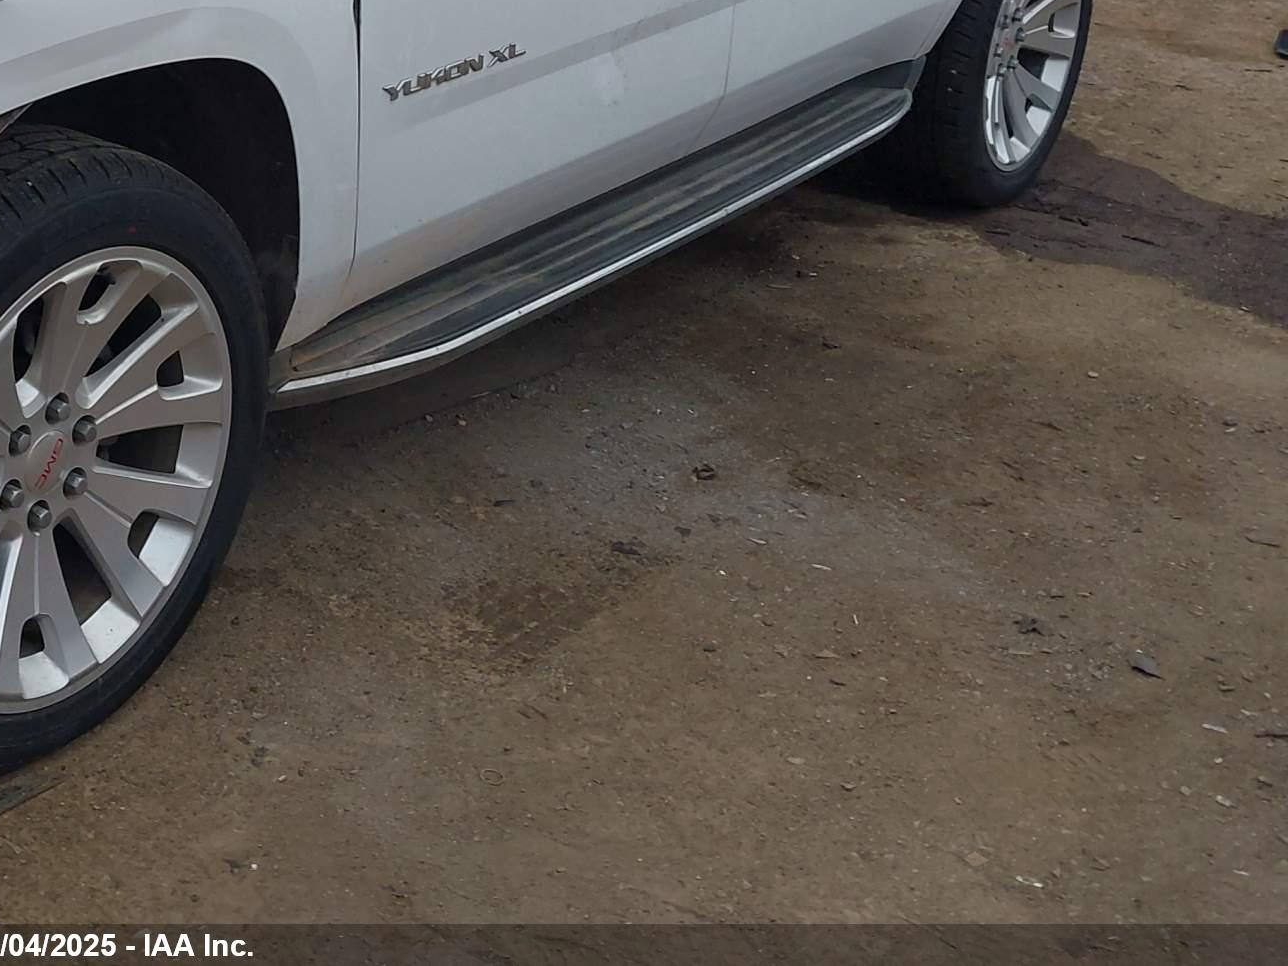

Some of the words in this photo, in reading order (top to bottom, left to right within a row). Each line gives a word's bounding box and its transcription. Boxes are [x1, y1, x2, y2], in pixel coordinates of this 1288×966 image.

[381, 53, 484, 101] YUKON
[487, 42, 526, 68] XL
[33, 438, 64, 490] GMC
